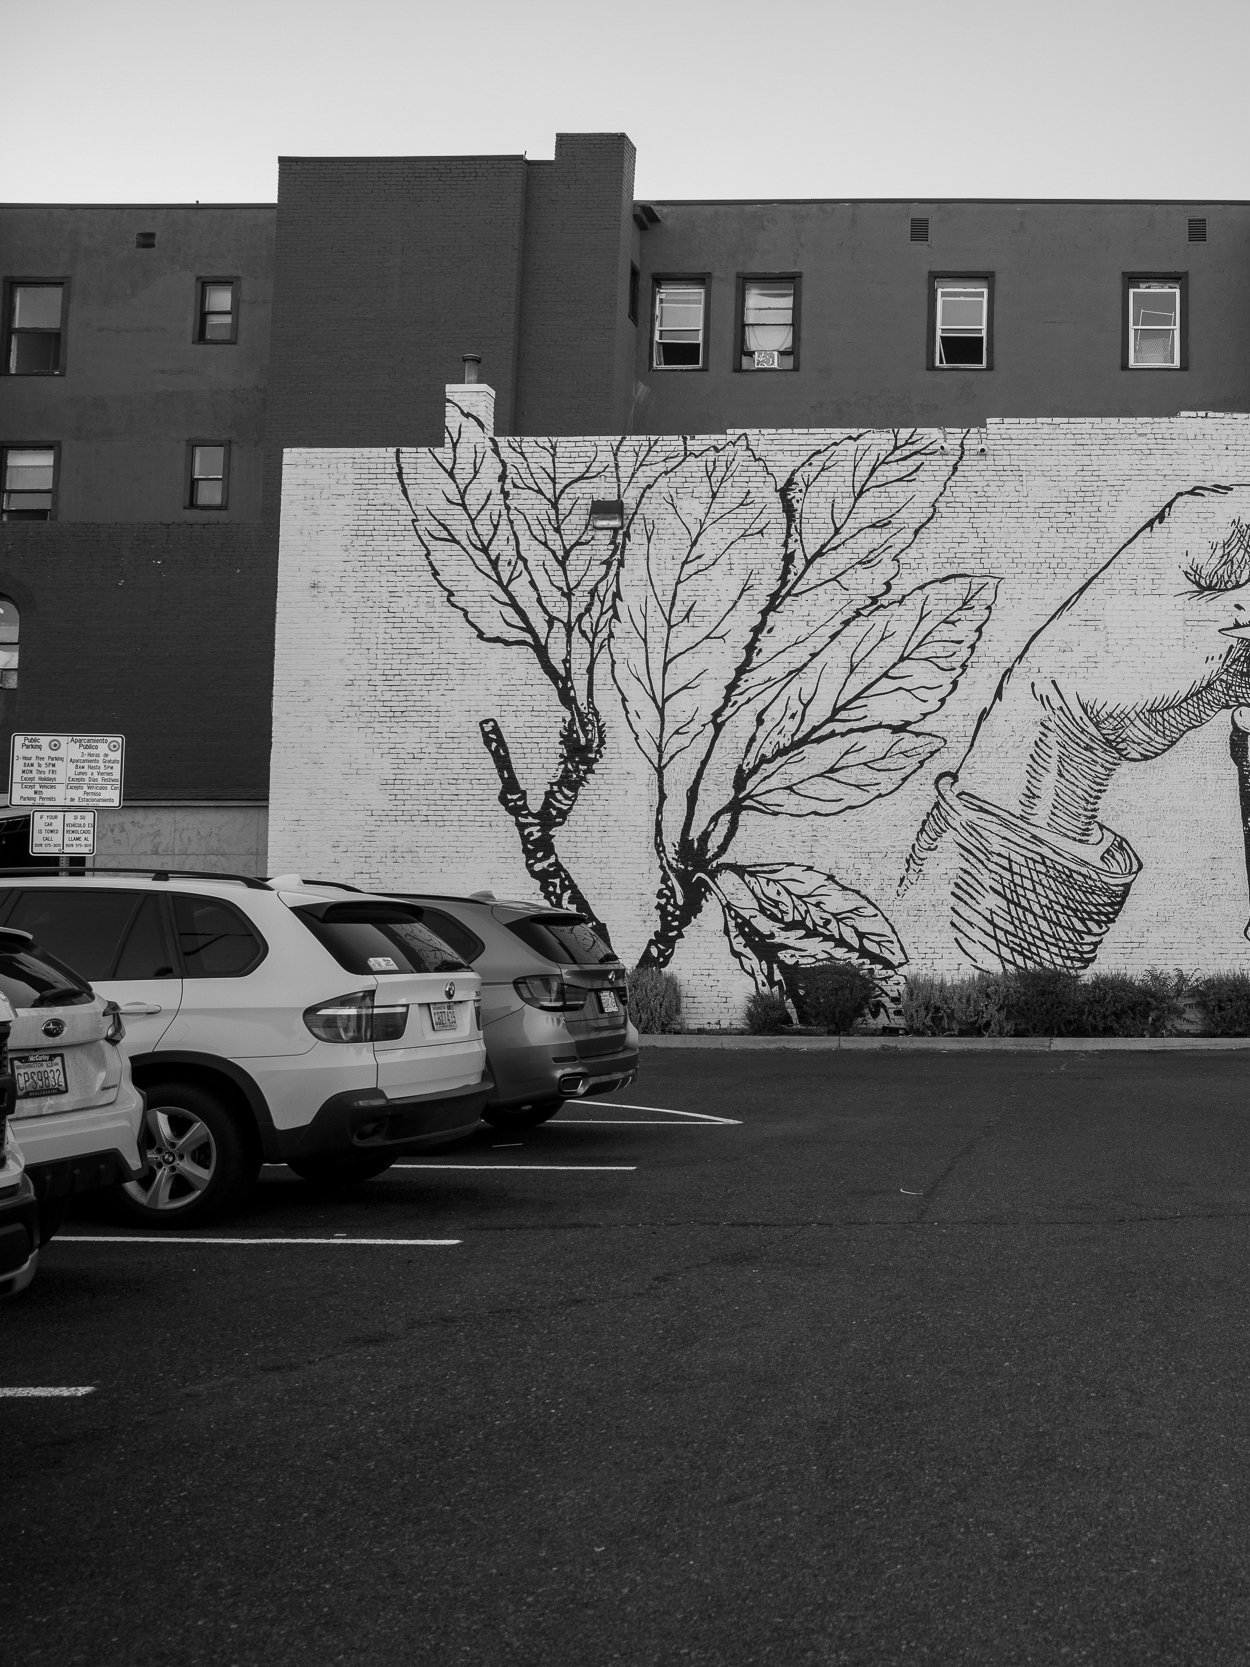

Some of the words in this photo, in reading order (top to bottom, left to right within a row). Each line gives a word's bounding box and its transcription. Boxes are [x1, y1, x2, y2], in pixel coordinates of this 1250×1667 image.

[22, 743, 42, 751] Parking
[47, 755, 65, 763] Parking
[16, 1062, 44, 1070] WASHINGTON
[16, 1069, 63, 1091] CPS9832
